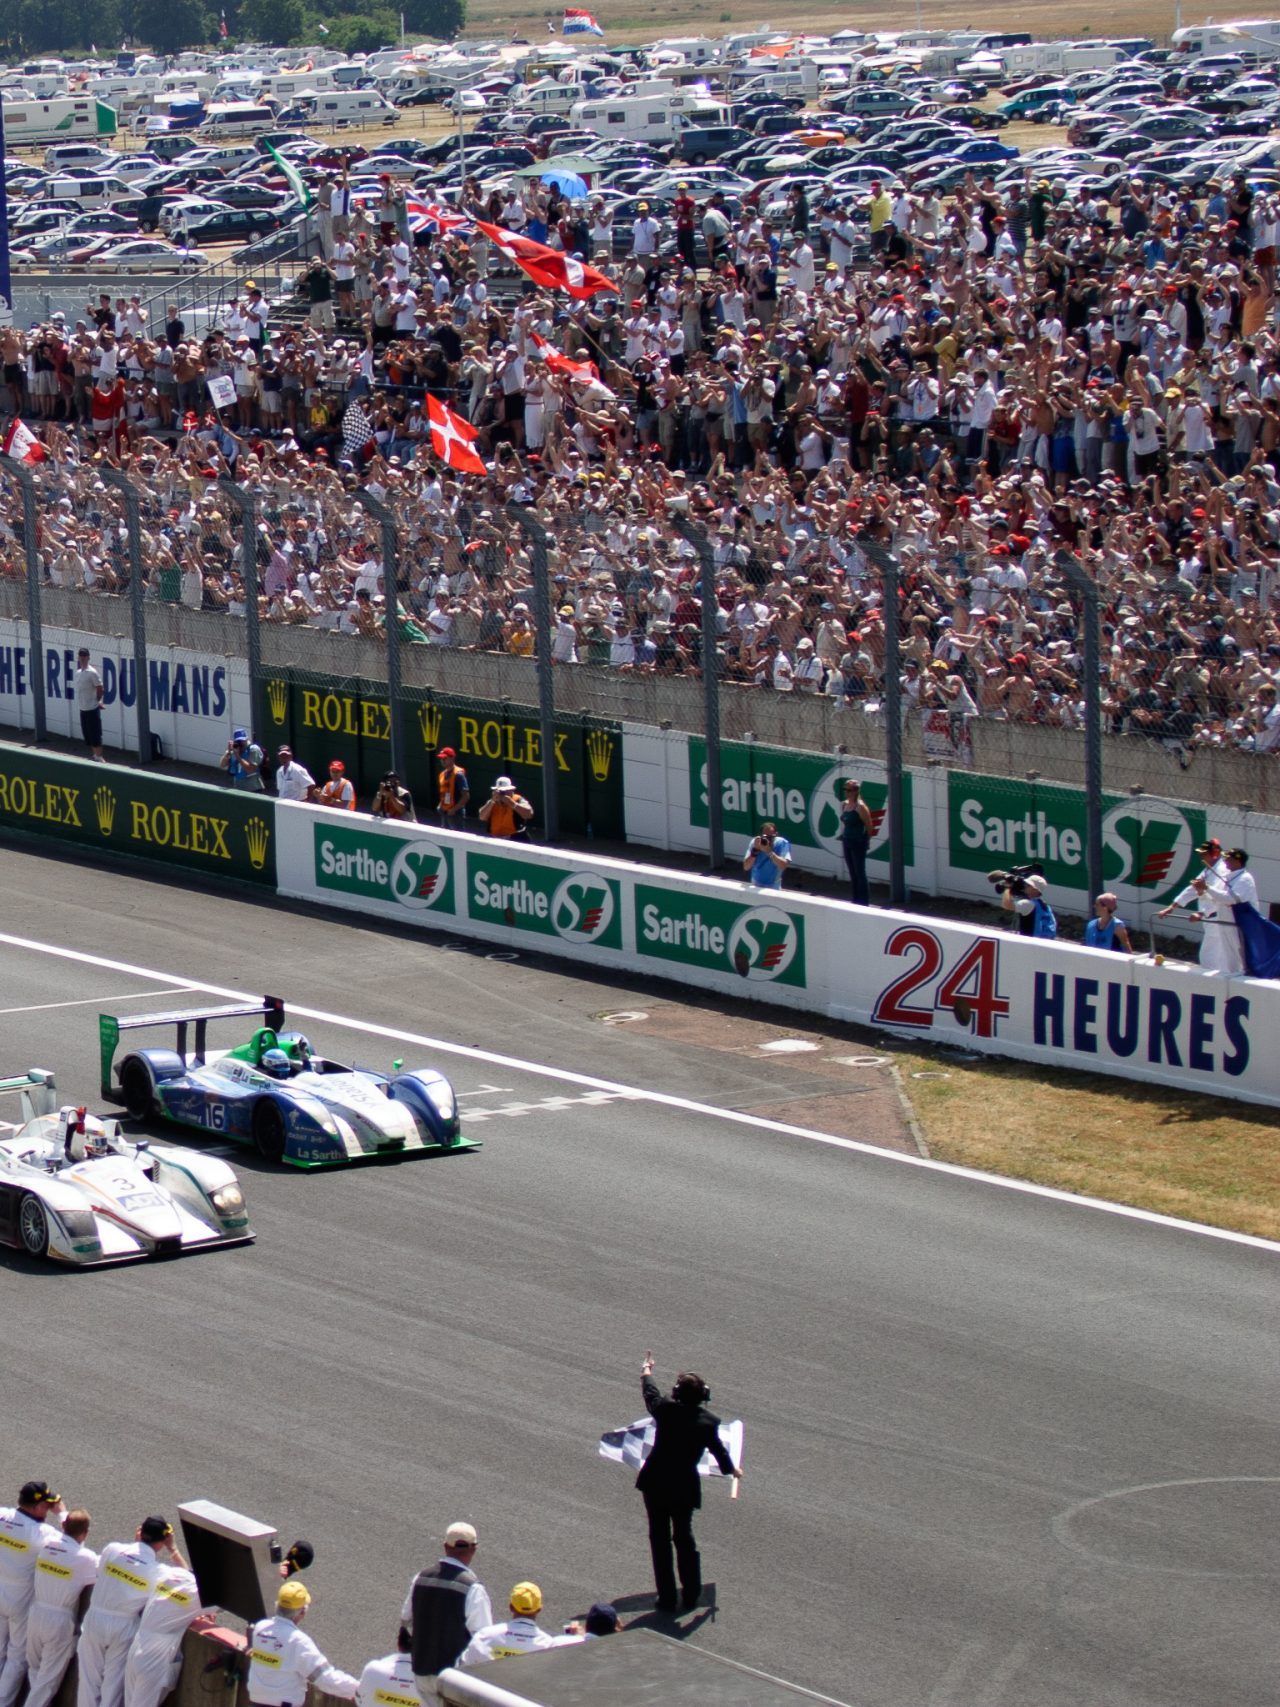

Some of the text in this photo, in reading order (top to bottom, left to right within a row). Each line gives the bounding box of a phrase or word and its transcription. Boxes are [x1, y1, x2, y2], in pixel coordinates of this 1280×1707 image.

[102, 656, 138, 708] DU
[149, 659, 226, 717] MANS
[302, 689, 394, 741] ROLEX
[458, 716, 570, 772] ROLEX
[130, 800, 232, 860] ROLEX
[960, 798, 1082, 866] Sarthe
[321, 840, 389, 886] Sarthe
[474, 871, 549, 918] Sarthe
[642, 904, 725, 955] Sarthe
[871, 924, 1251, 1077] 24 HEURES
[206, 1103, 225, 1131] 16
[297, 1147, 310, 1159] La
[112, 1177, 135, 1191] 3
[110, 1567, 148, 1588] DUNLOP
